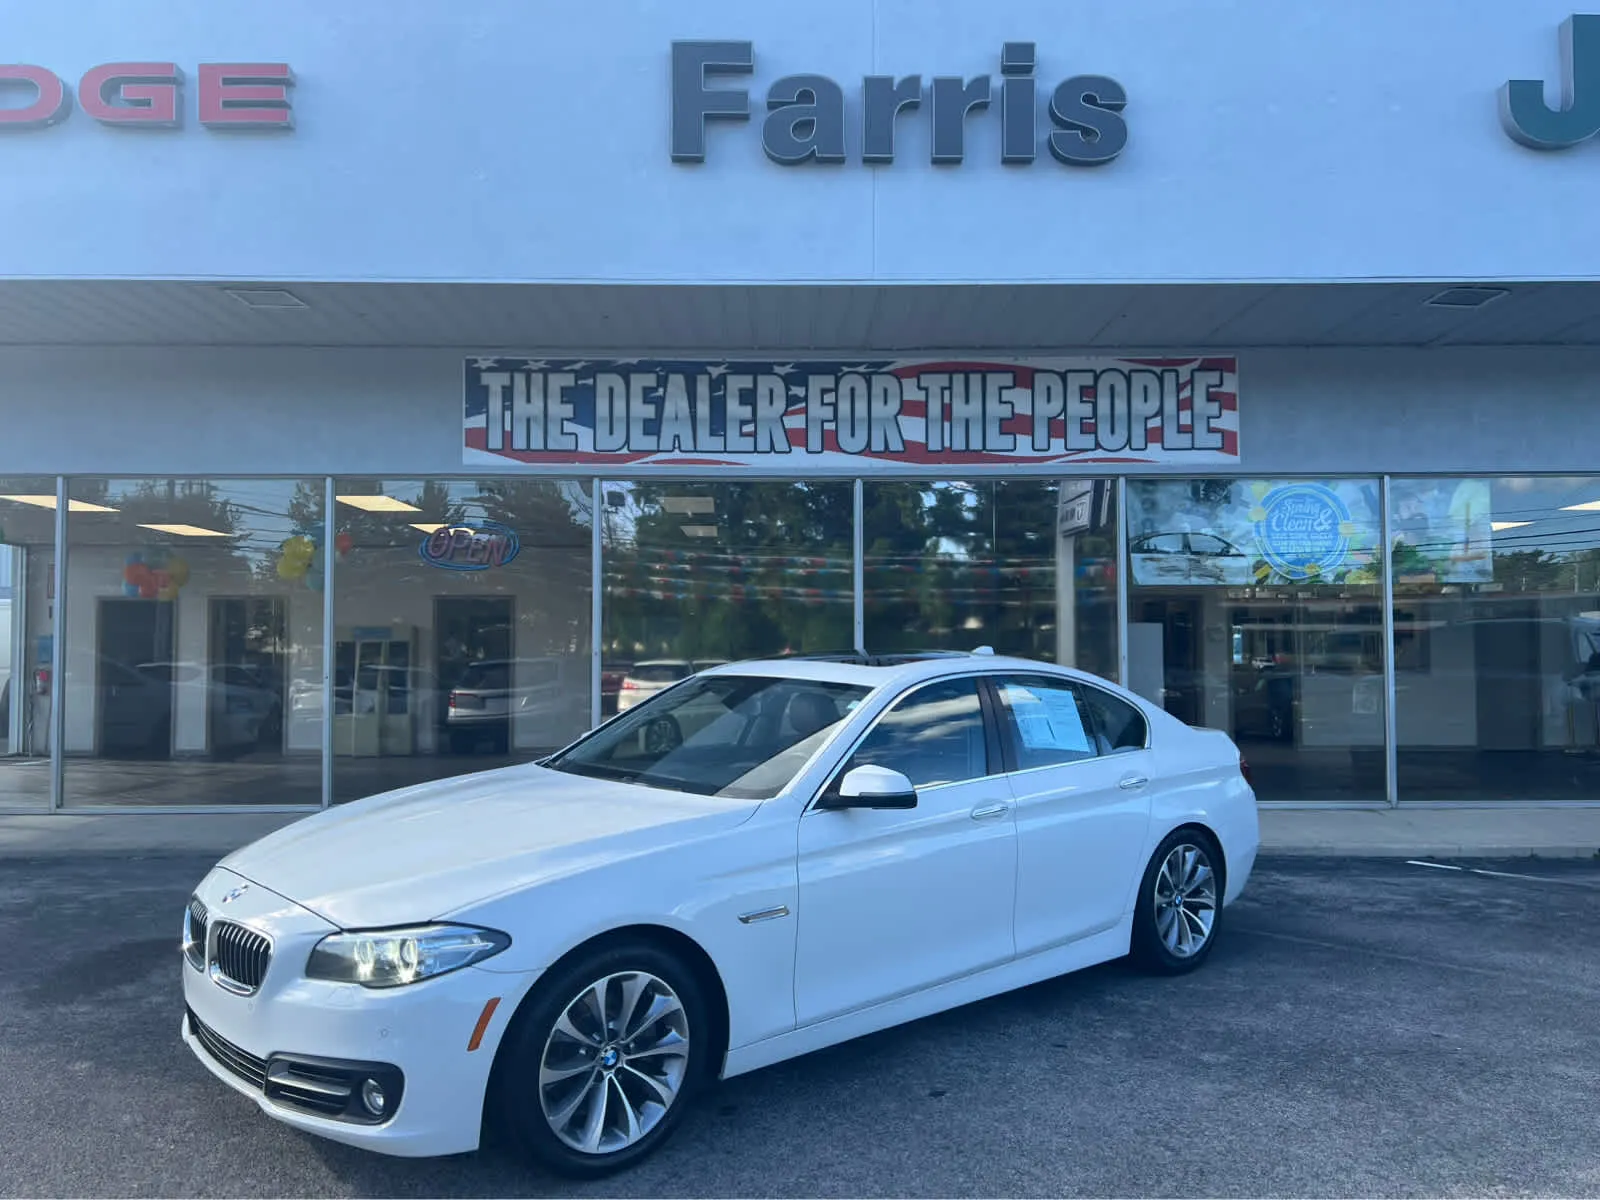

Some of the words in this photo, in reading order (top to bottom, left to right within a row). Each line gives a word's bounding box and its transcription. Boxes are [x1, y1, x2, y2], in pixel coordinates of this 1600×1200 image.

[671, 40, 1128, 165] Farris
[481, 371, 577, 452] THE
[594, 371, 792, 454] DEALER
[806, 370, 905, 454] FOR
[918, 371, 1016, 453] THE
[1032, 368, 1224, 452] PEOPLE
[1271, 510, 1313, 532] Clean
[1282, 497, 1321, 519] Spring
[428, 527, 508, 567] OPEN
